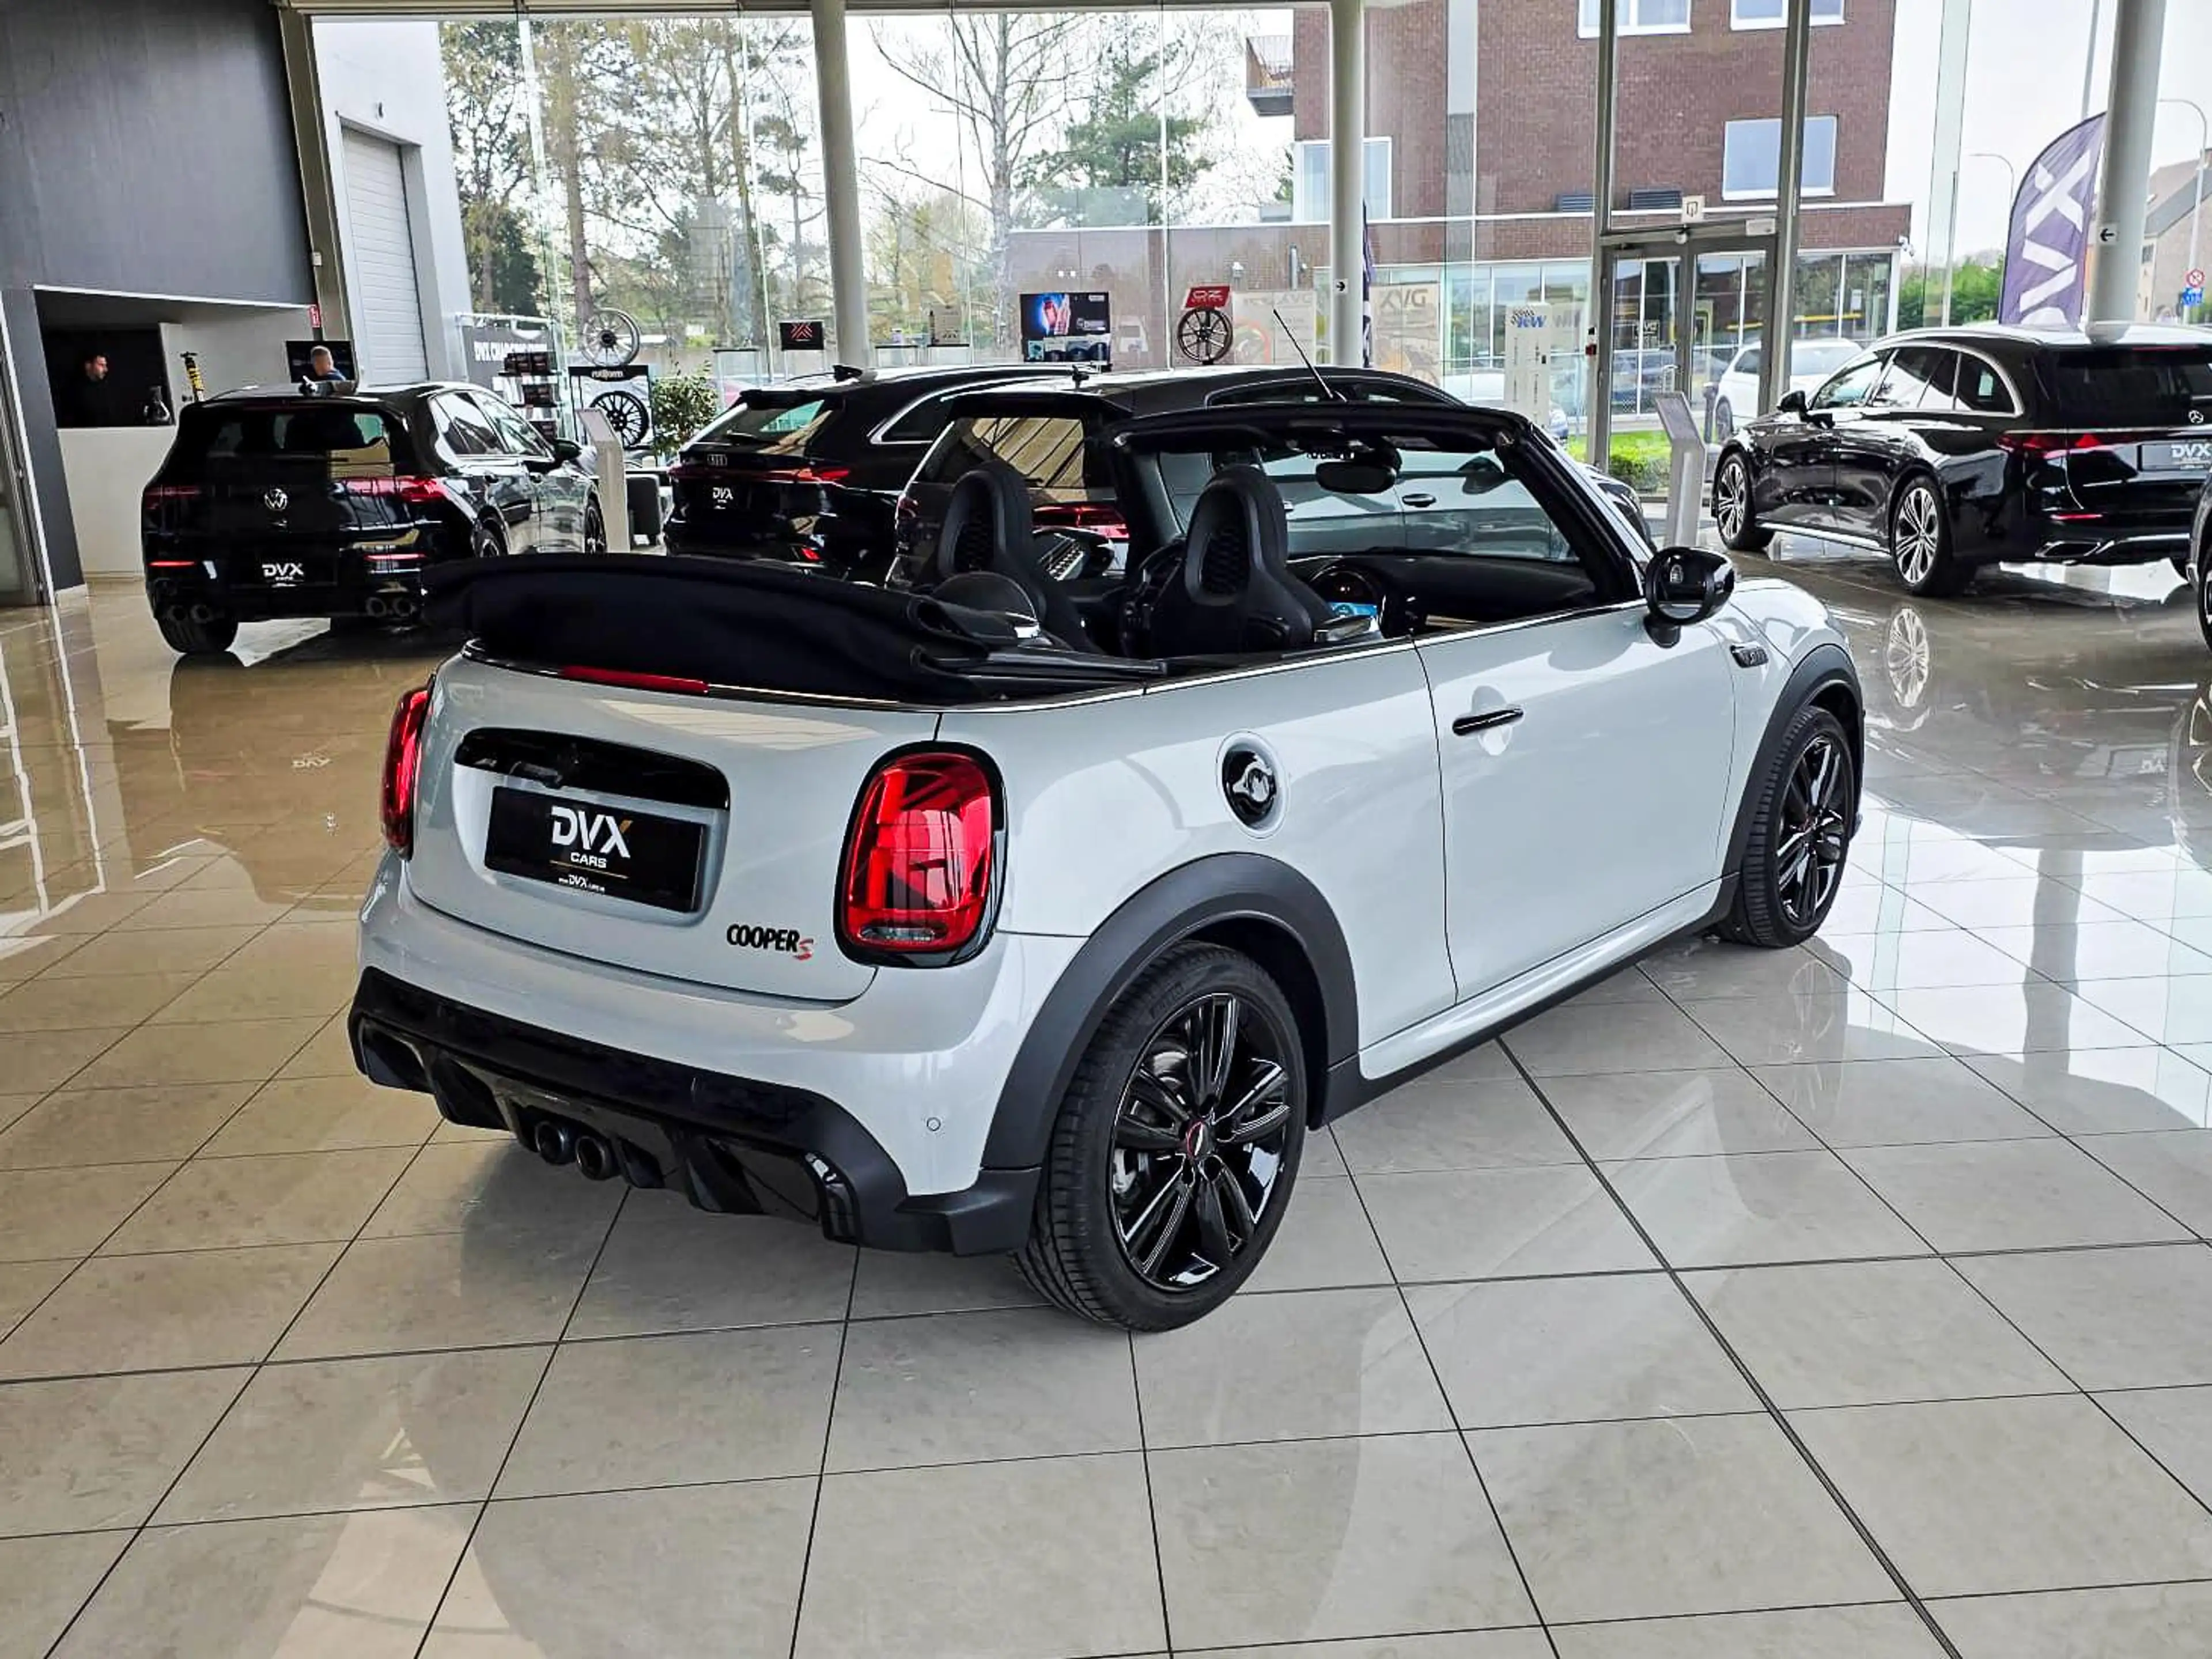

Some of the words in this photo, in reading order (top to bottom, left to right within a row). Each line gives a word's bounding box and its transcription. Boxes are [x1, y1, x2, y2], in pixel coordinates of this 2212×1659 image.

[2171, 443, 2212, 459] DVX
[262, 563, 304, 577] DVX
[551, 805, 633, 859] DVX
[570, 852, 607, 869] CARS
[727, 923, 800, 952] COOPER
[793, 938, 814, 961] S
